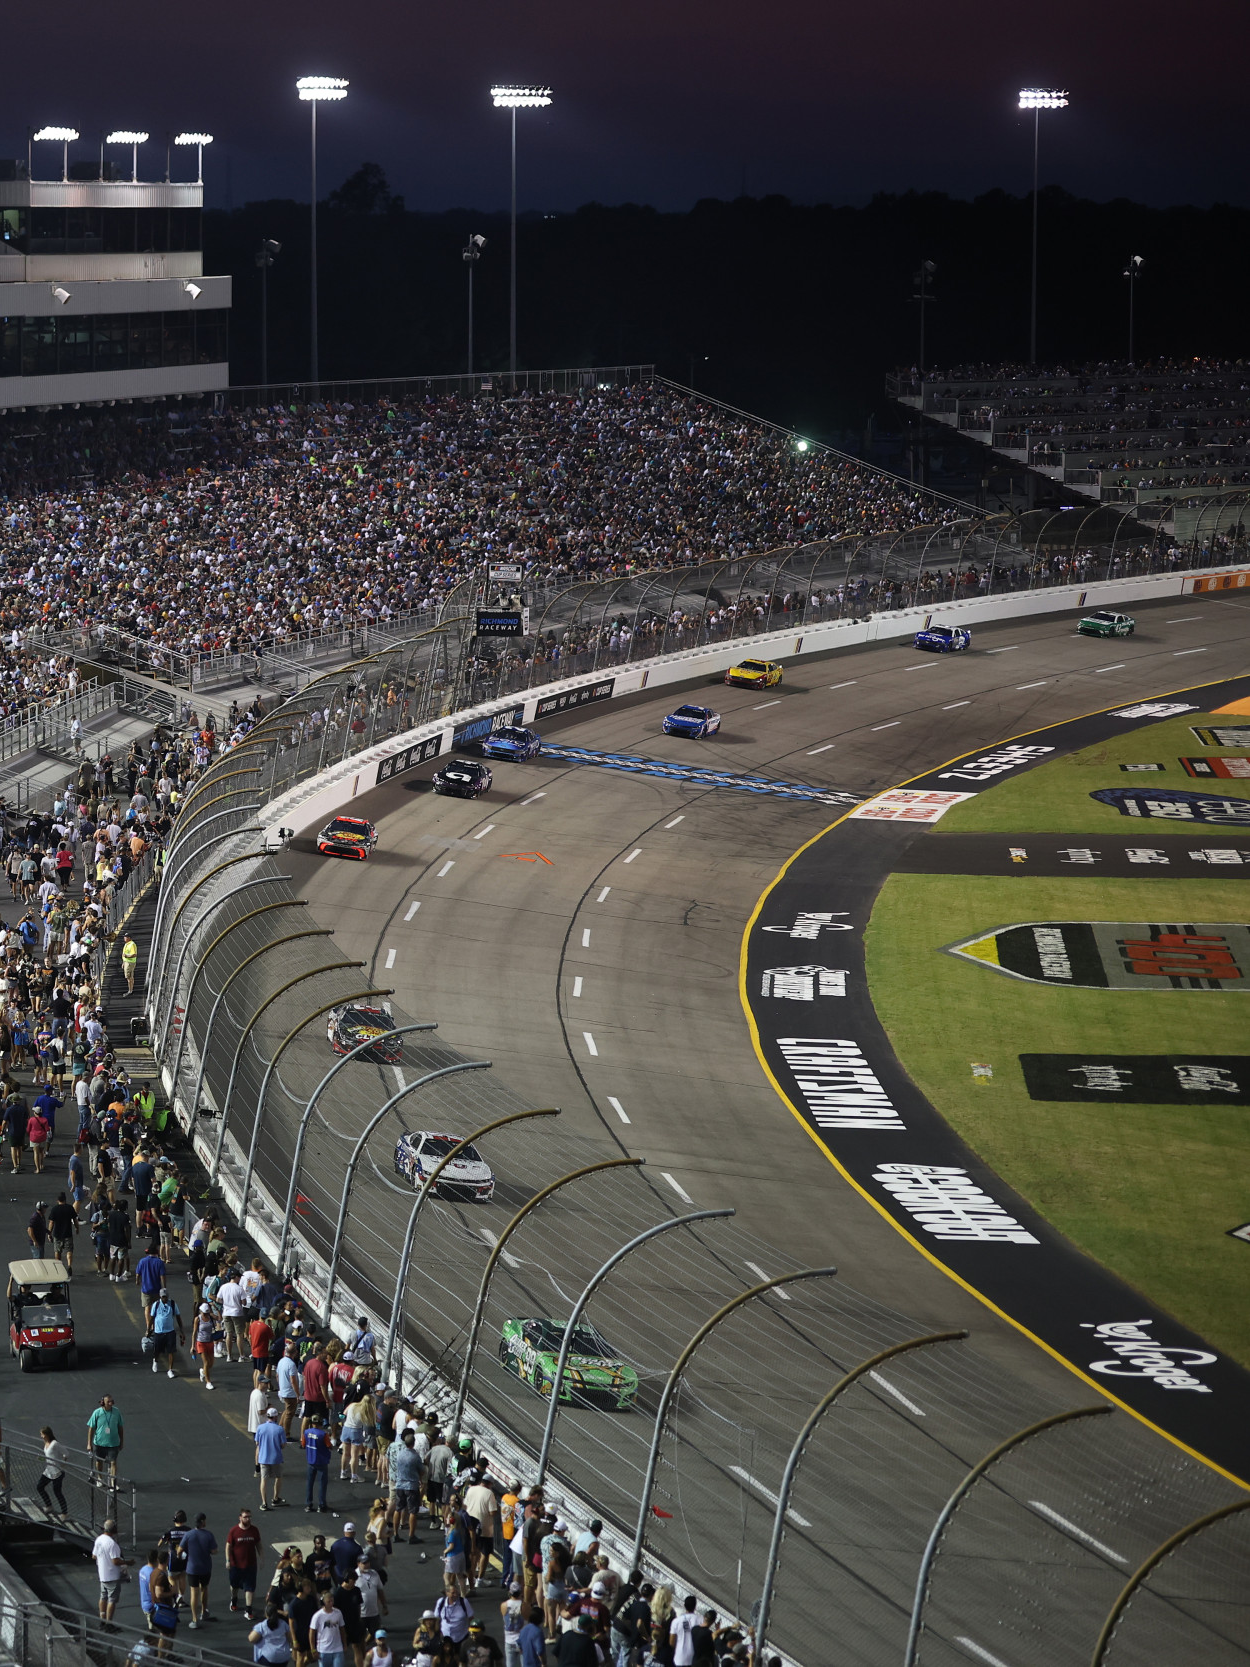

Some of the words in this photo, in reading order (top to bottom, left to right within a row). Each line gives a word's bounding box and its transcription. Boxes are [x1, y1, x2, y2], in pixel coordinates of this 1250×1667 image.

[460, 718, 493, 743] RICHMOND
[491, 709, 516, 732] RACEWAY
[938, 745, 1055, 781] SHEETZ
[1145, 800, 1194, 819] 250
[1039, 953, 1073, 979] RACEWAY
[1115, 934, 1244, 980] 400
[775, 1037, 907, 1131] CRAFTSMAN
[1088, 1335, 1218, 1394] Kroger
